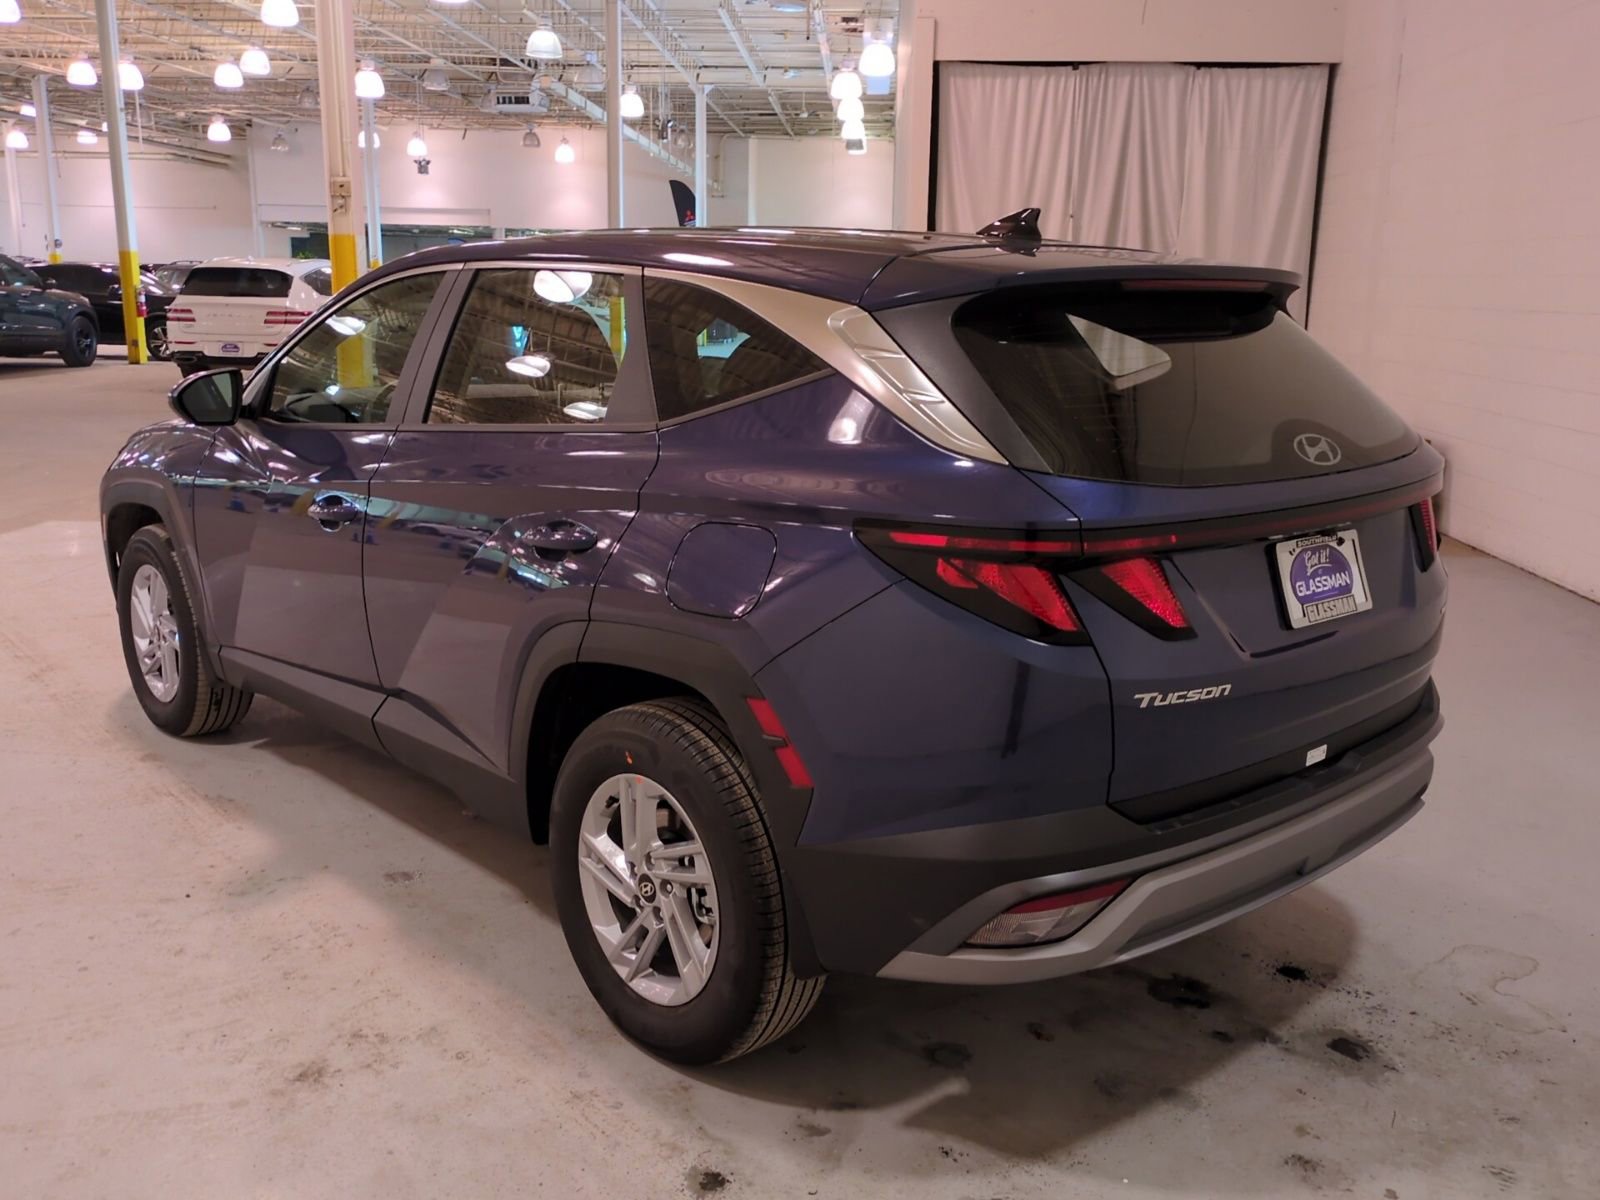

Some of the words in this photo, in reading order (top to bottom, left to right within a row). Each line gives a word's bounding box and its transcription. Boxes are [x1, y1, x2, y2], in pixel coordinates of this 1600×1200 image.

[1304, 550, 1320, 568] Got
[1295, 571, 1351, 597] GLASSMAN
[1307, 597, 1357, 622] GLASSMAN
